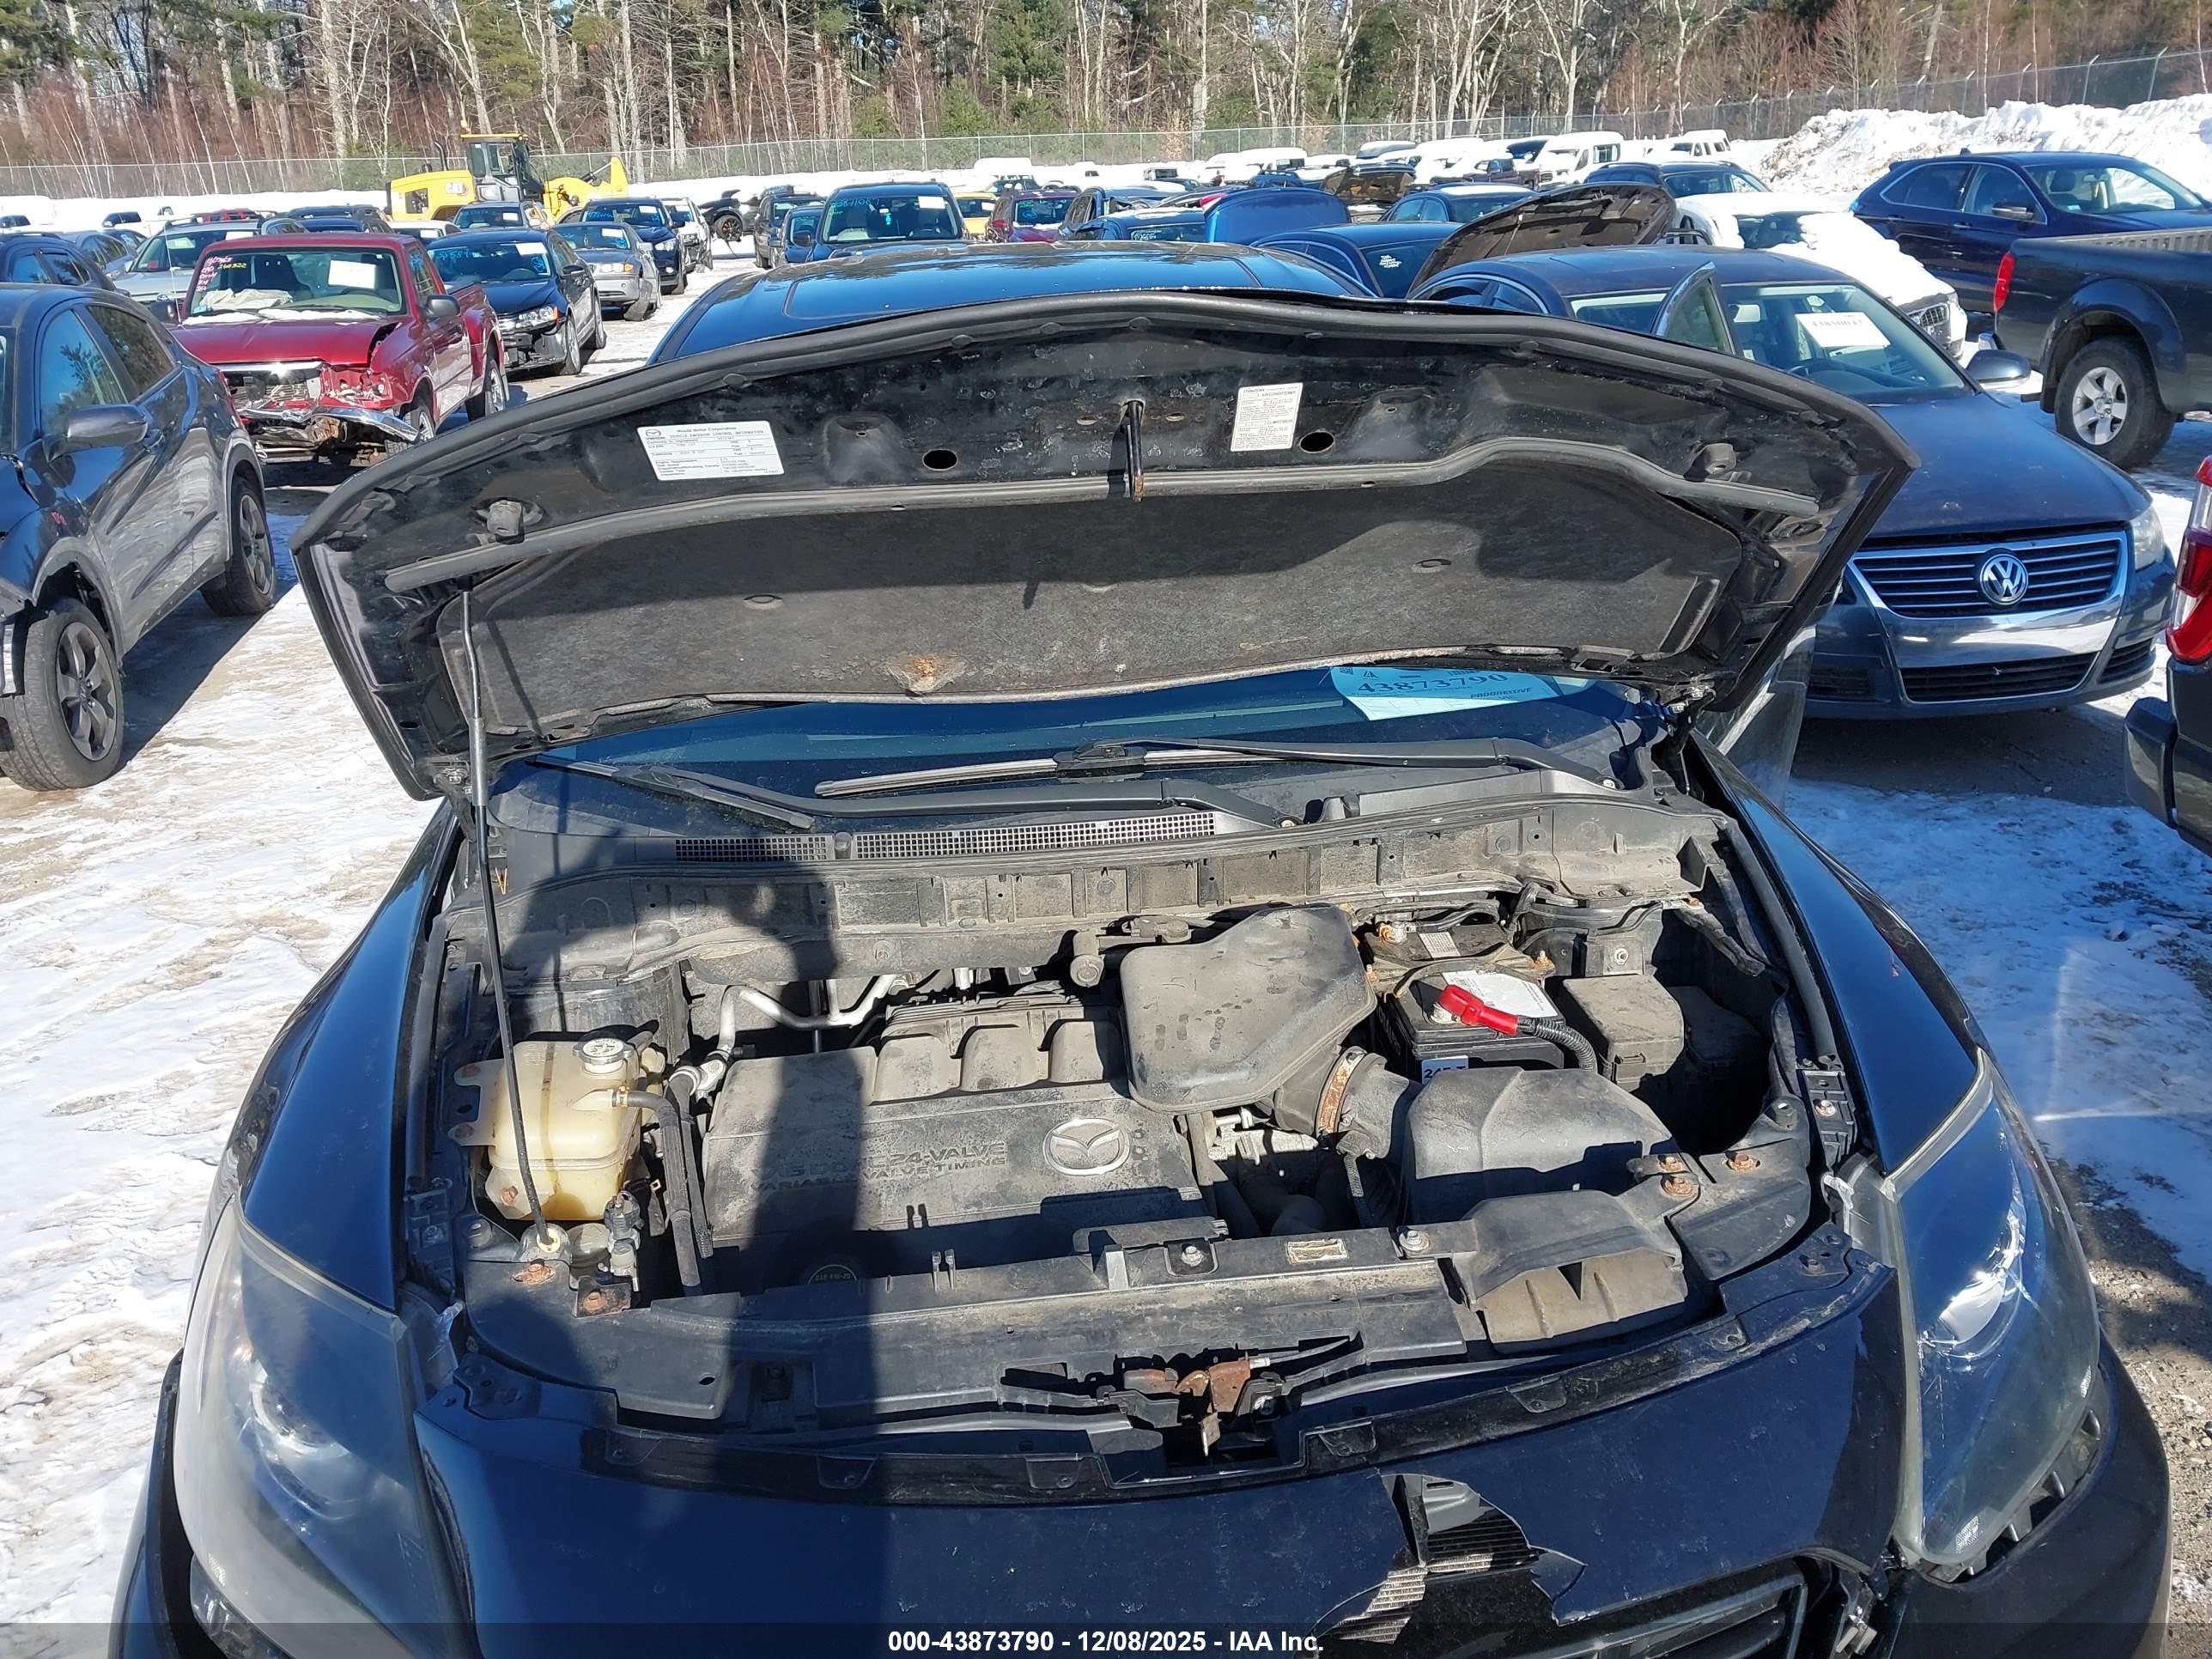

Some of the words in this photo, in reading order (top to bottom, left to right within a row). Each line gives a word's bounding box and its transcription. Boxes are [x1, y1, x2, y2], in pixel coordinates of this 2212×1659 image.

[1358, 673, 1509, 693] 43873790
[890, 1141, 1006, 1166] 24-VALVE
[862, 1166, 929, 1181] VALVE
[933, 1157, 1006, 1172] TIMING
